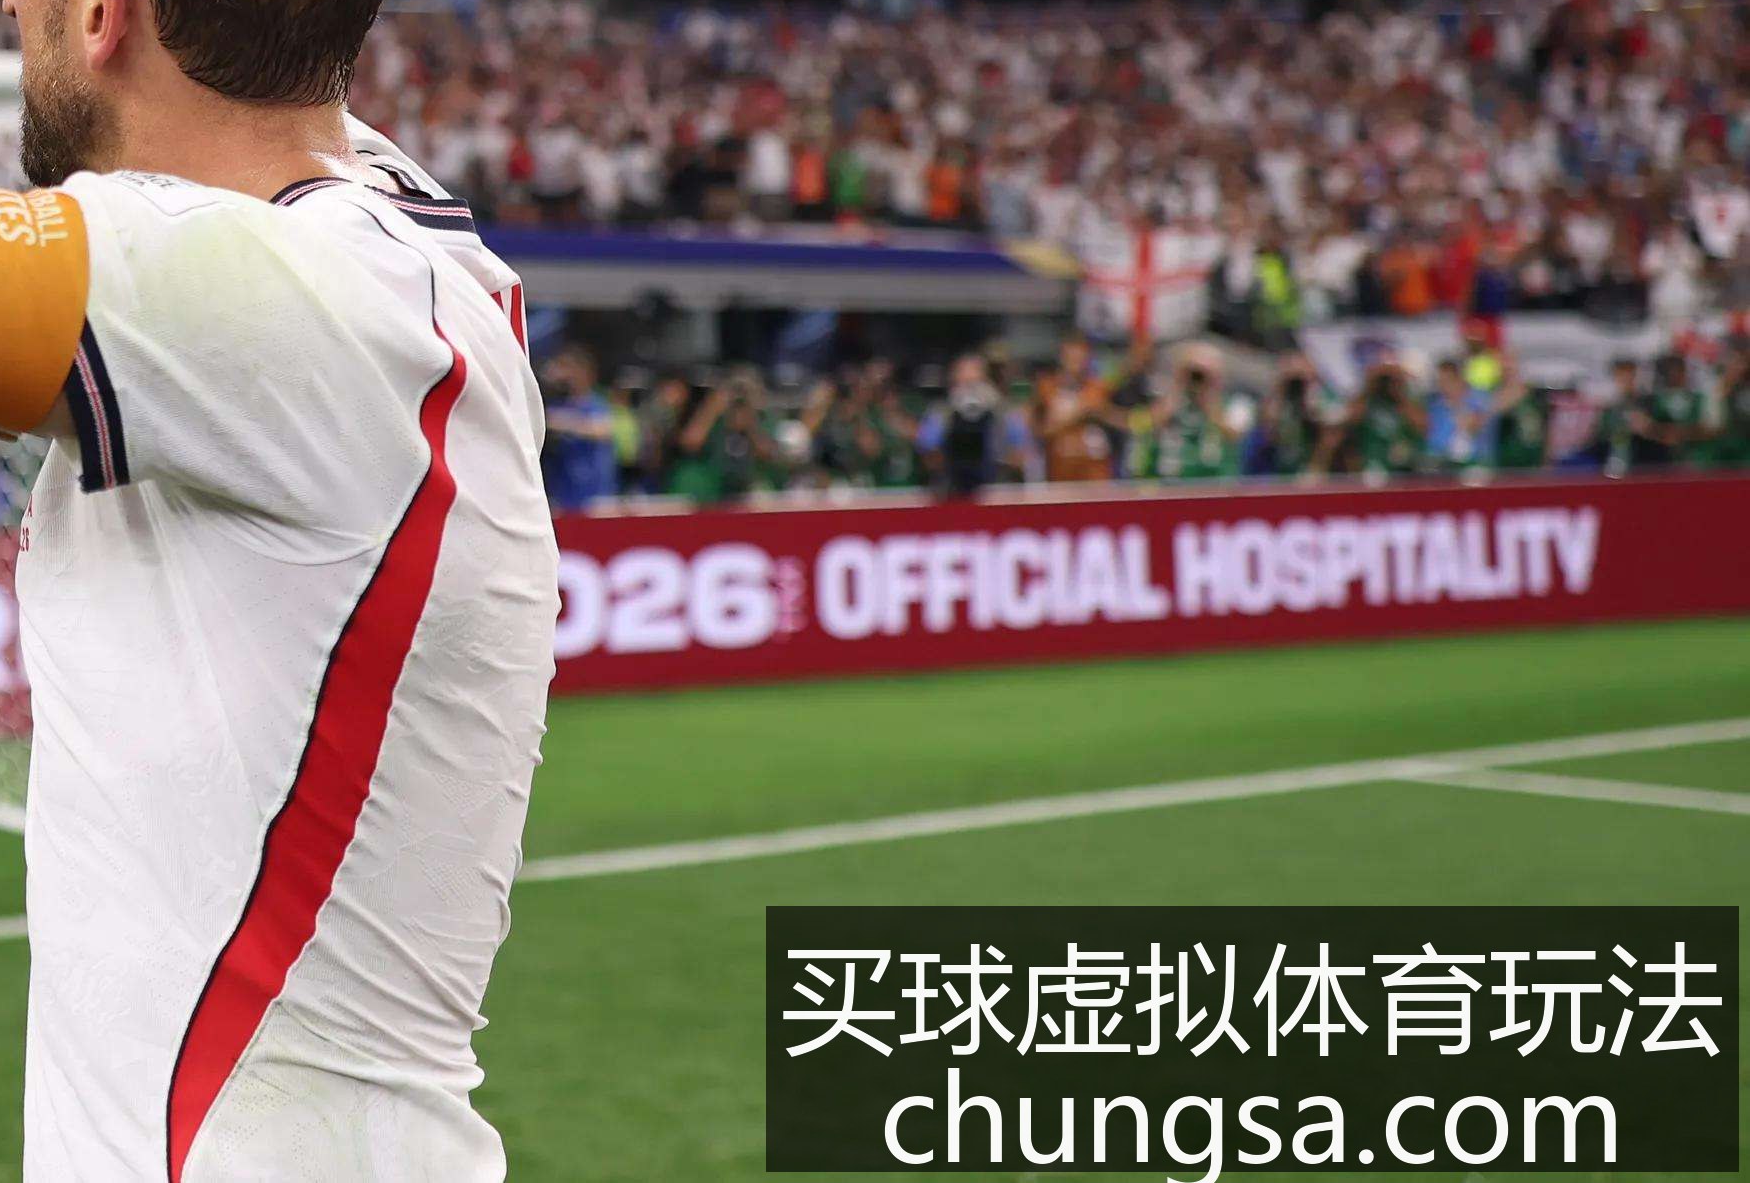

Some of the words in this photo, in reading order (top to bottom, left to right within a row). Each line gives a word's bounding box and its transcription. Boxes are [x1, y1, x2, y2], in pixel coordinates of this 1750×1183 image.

[26, 186, 69, 248] BALL
[553, 542, 776, 658] 026
[815, 526, 1170, 639] OFFICIAL
[1173, 508, 1598, 616] HOSPITALITY
